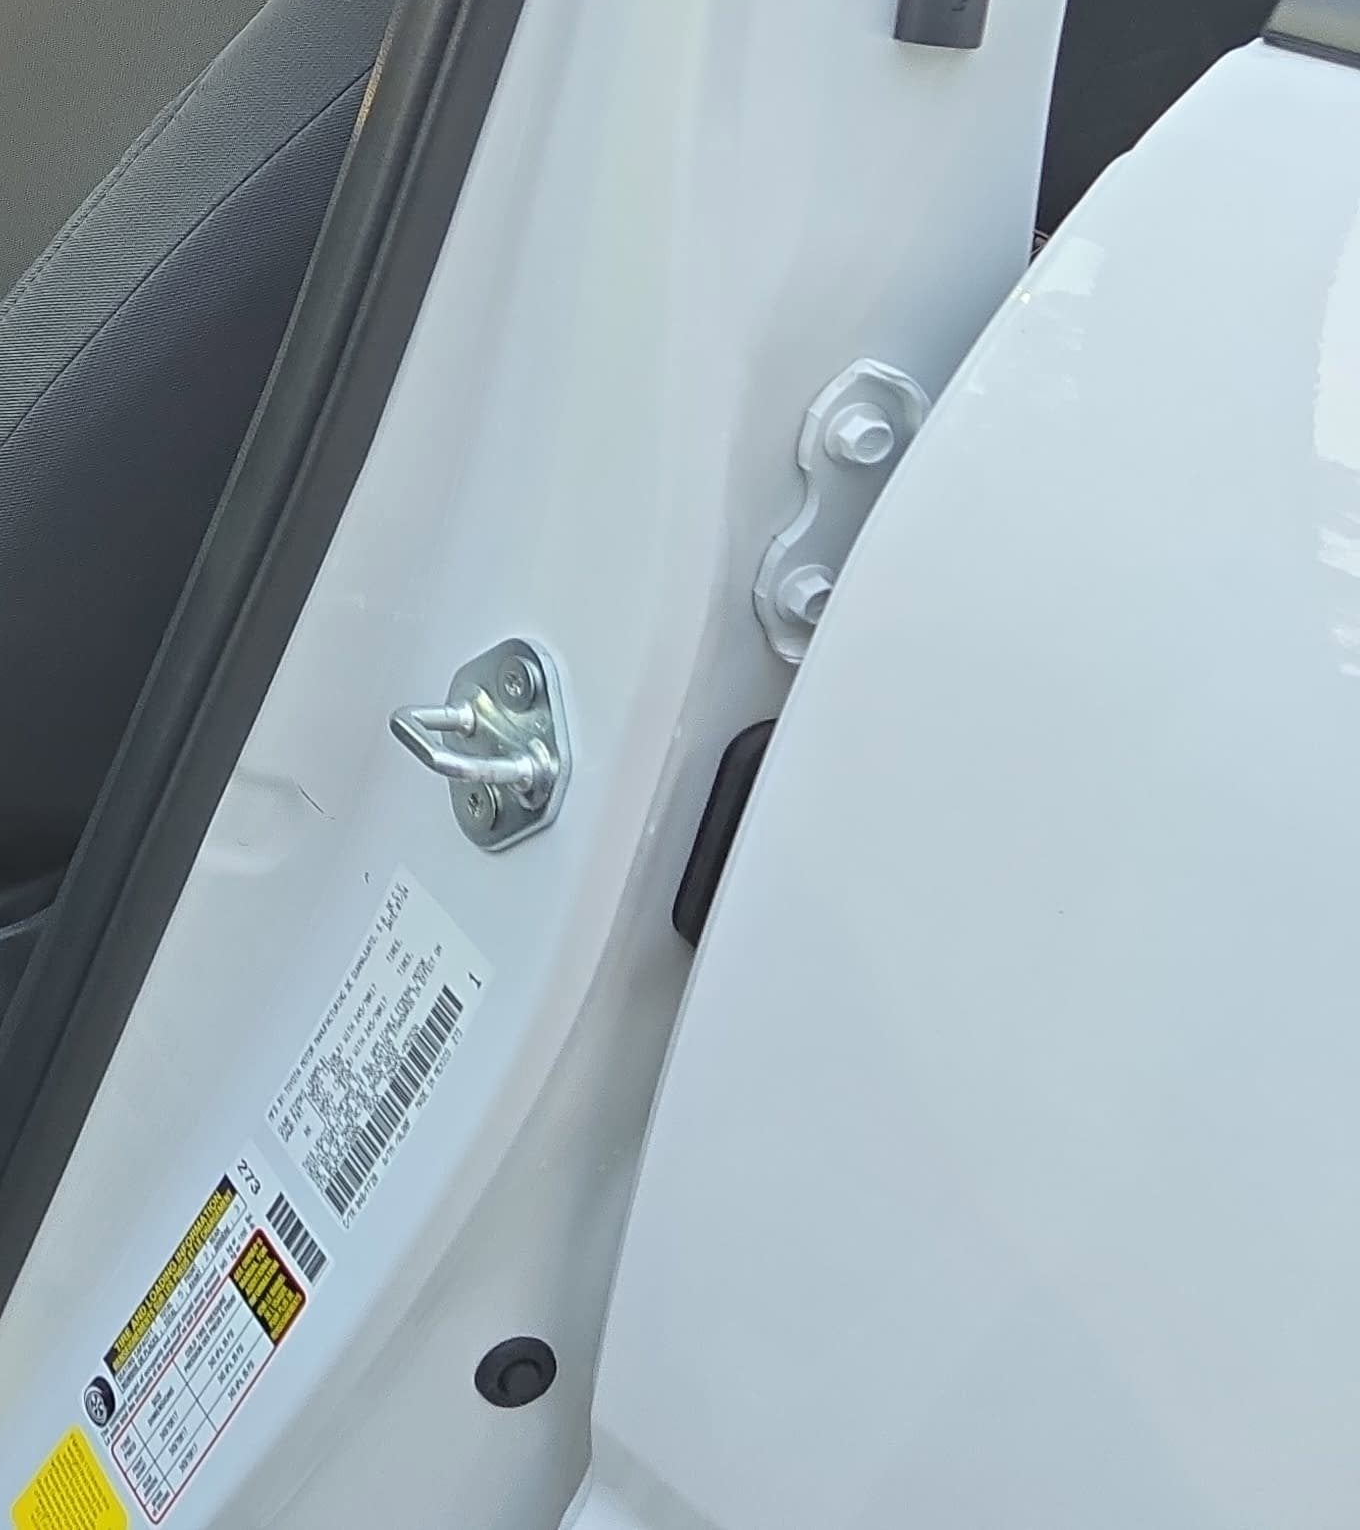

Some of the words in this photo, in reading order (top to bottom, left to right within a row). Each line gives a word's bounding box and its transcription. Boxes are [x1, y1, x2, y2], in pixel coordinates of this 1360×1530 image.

[465, 967, 482, 991] 1
[282, 1063, 302, 1096] TOYOTA
[237, 1158, 261, 1195] 273
[112, 1324, 133, 1355] TIRE
[128, 1301, 148, 1332] AND
[143, 1257, 178, 1310] LOADING
[173, 1189, 223, 1265] INFORMATION
